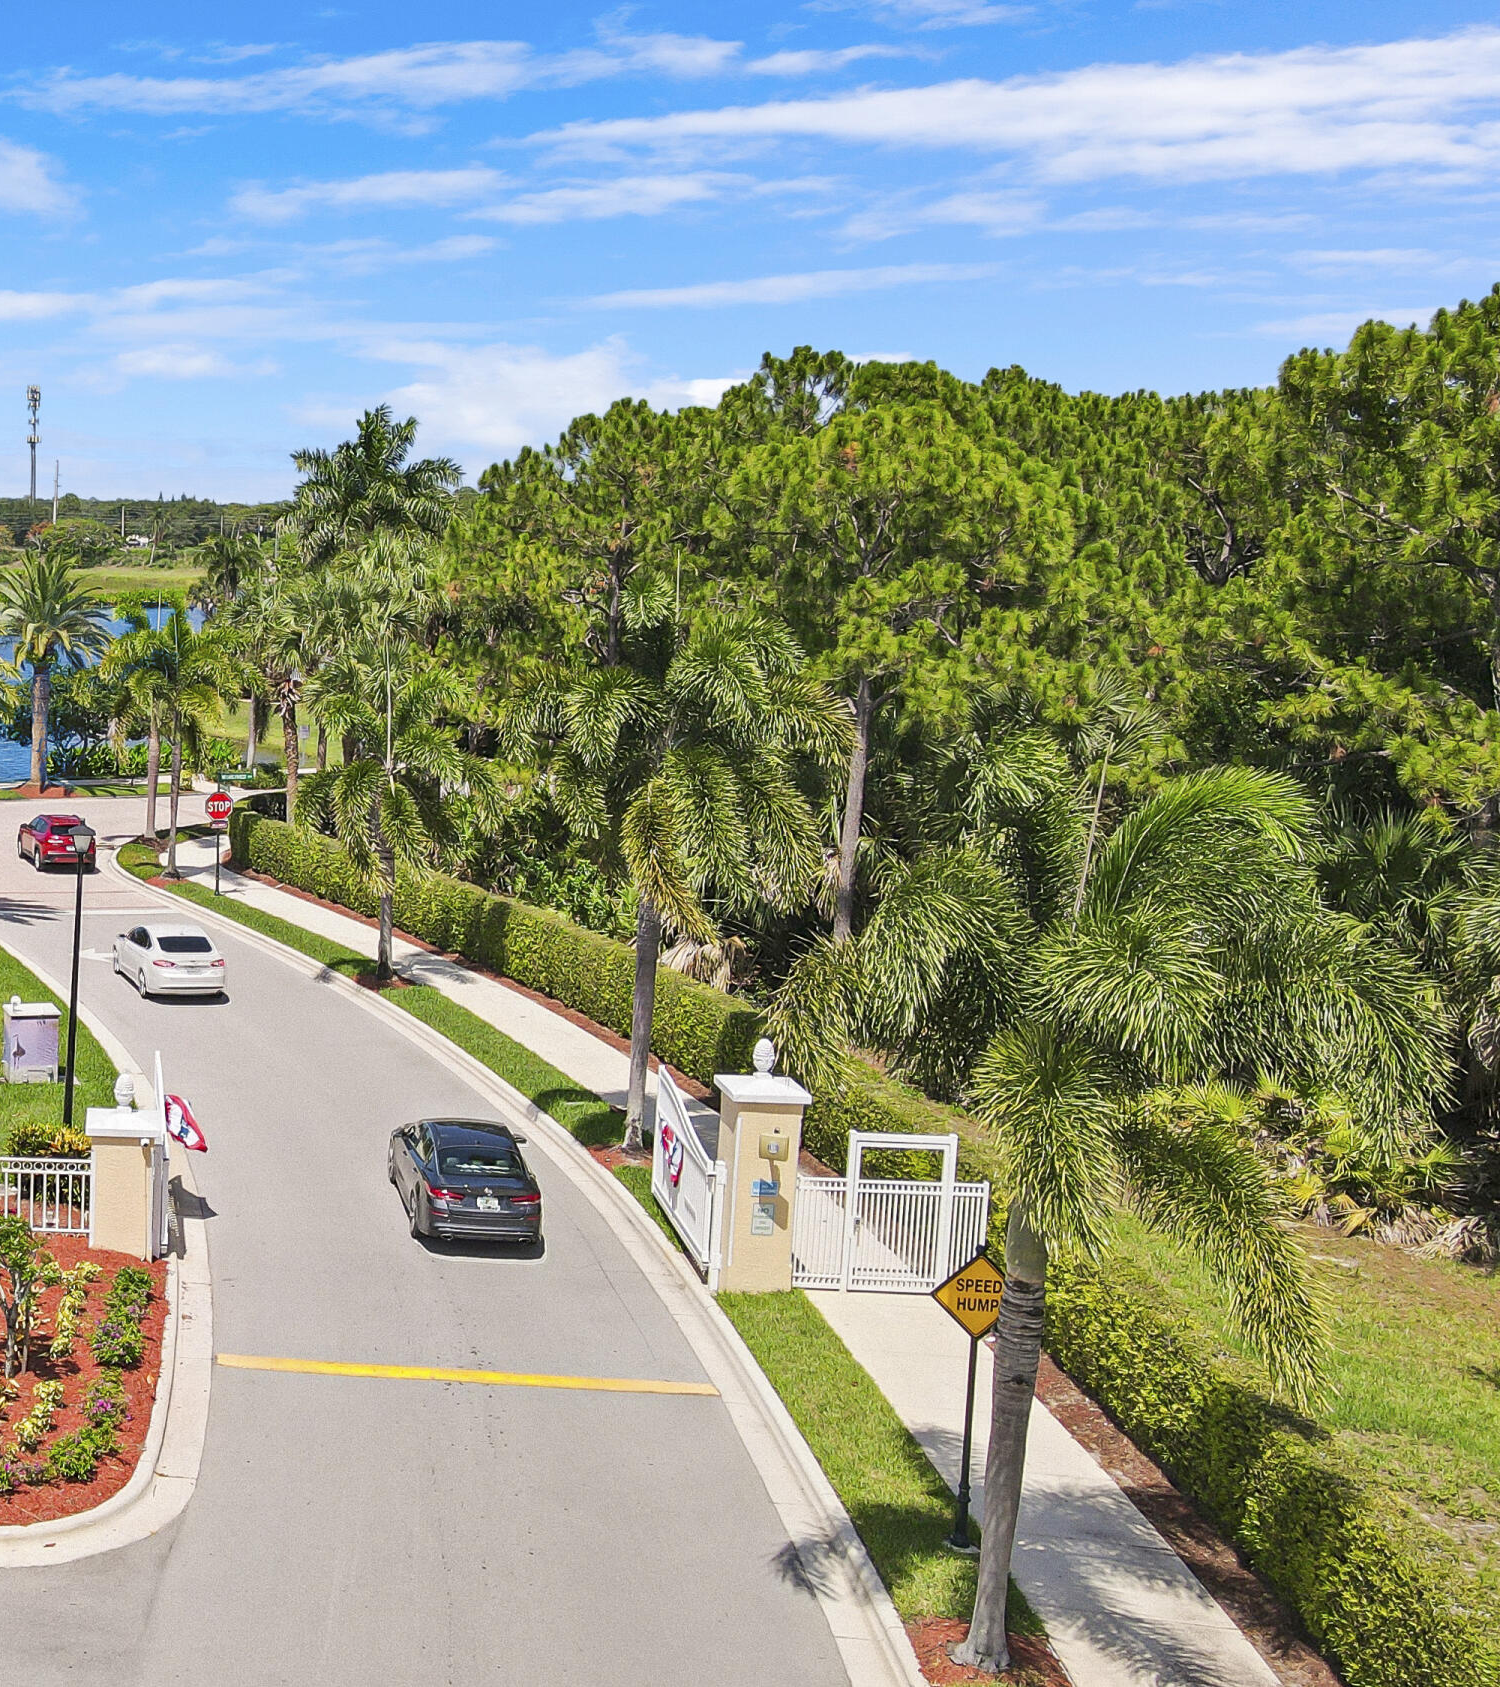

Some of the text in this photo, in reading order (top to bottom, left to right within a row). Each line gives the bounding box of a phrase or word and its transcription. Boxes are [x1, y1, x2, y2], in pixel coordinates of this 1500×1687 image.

[207, 801, 231, 812] STOP
[956, 1278, 1003, 1294] SPEED
[957, 1297, 999, 1312] HUMP
